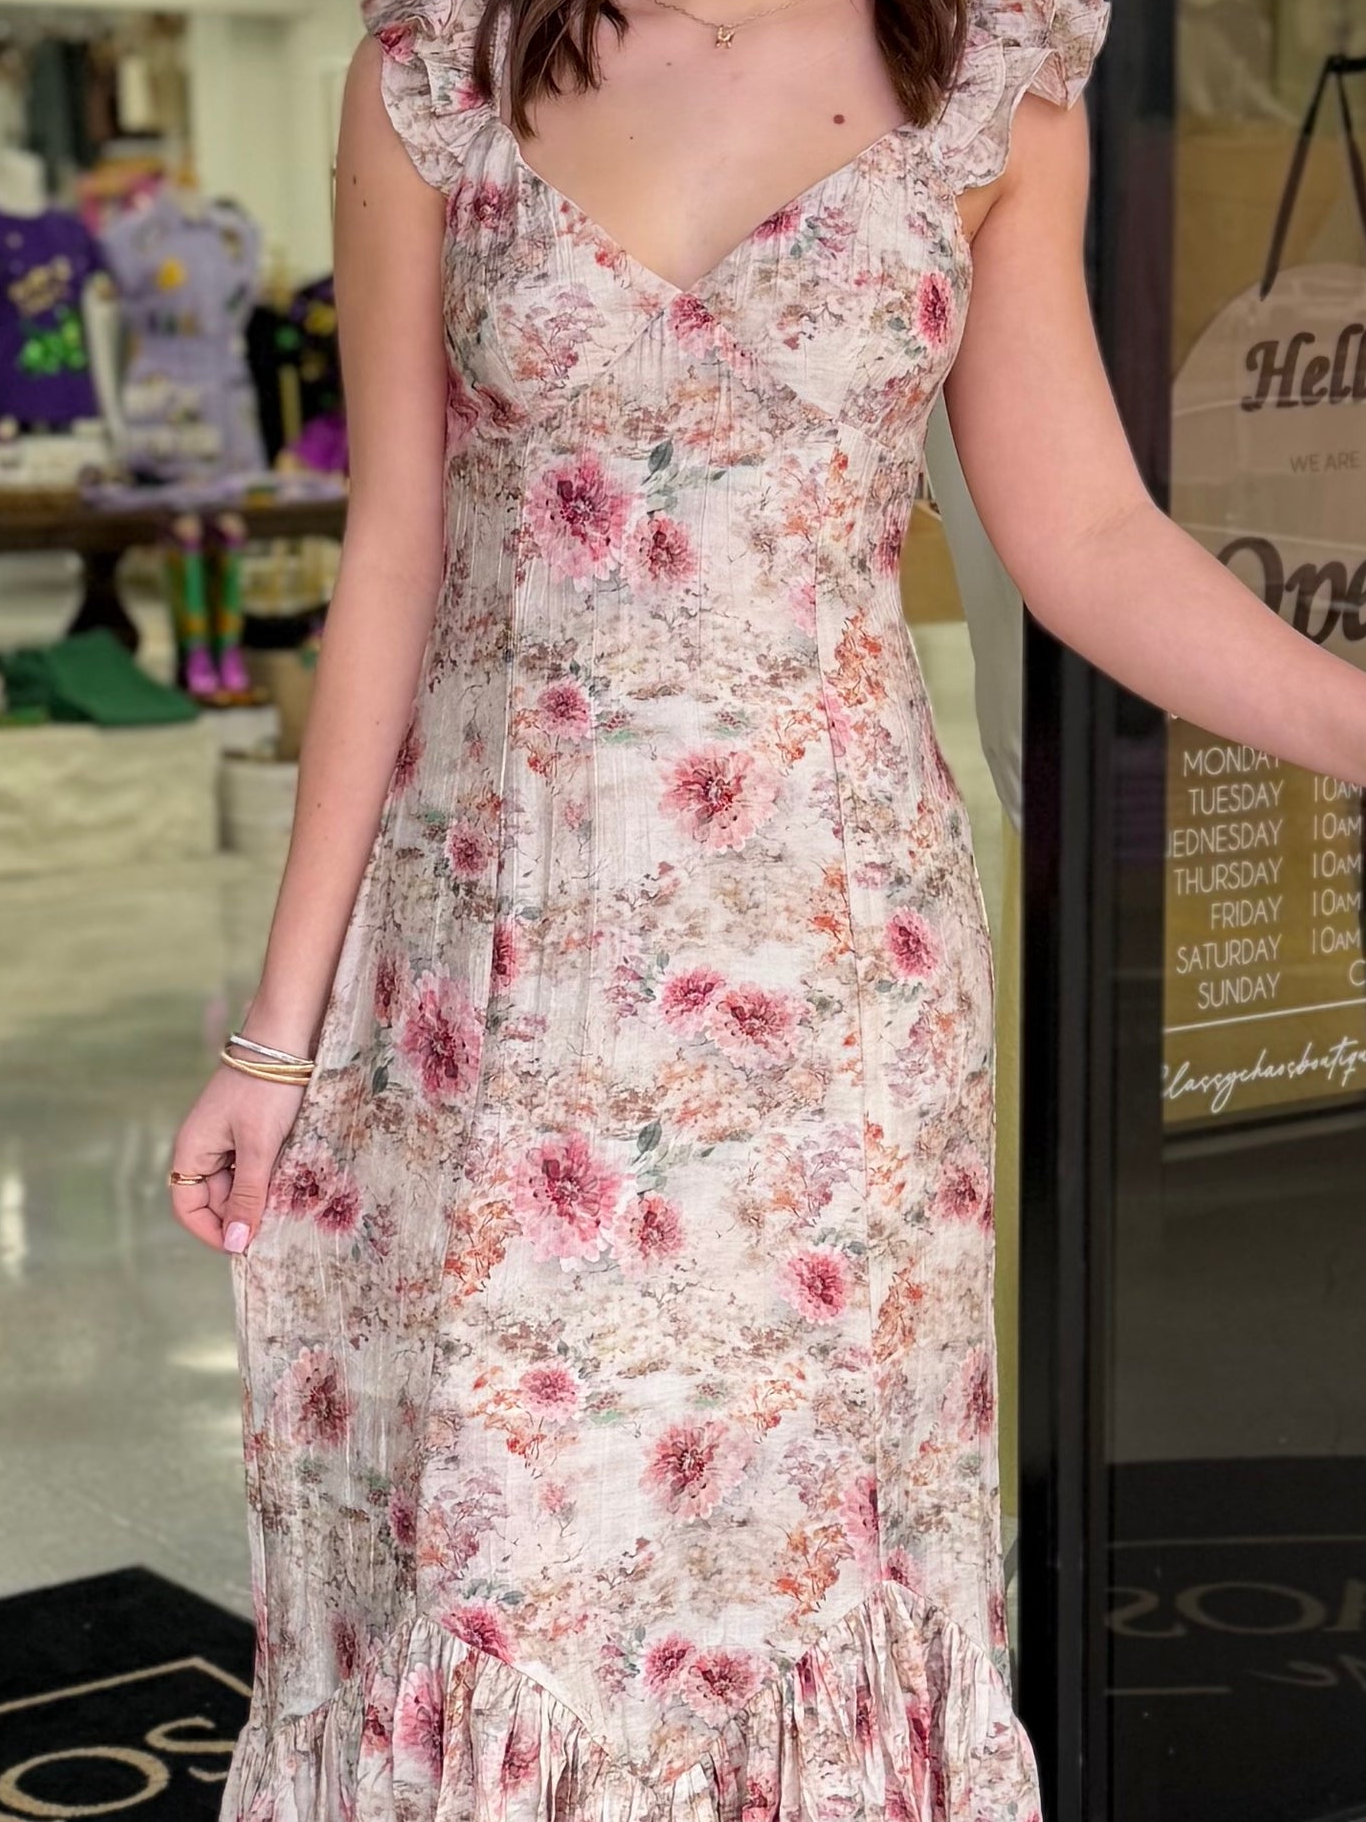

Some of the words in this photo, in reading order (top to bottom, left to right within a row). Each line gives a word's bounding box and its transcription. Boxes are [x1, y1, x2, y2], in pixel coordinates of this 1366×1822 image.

[1289, 452, 1321, 474] WE
[1323, 450, 1362, 471] ARE
[1188, 779, 1285, 816] TUESDAY
[1313, 812, 1362, 841] 10AM
[1173, 857, 1284, 896] THURSDAY
[1313, 850, 1362, 879] 10AM
[1210, 895, 1283, 931] FRIDAY
[1312, 888, 1362, 917] 10AM
[1176, 933, 1282, 975] SATURDAY
[1312, 926, 1361, 955] 10AM
[1197, 972, 1281, 1010] SUNDAY
